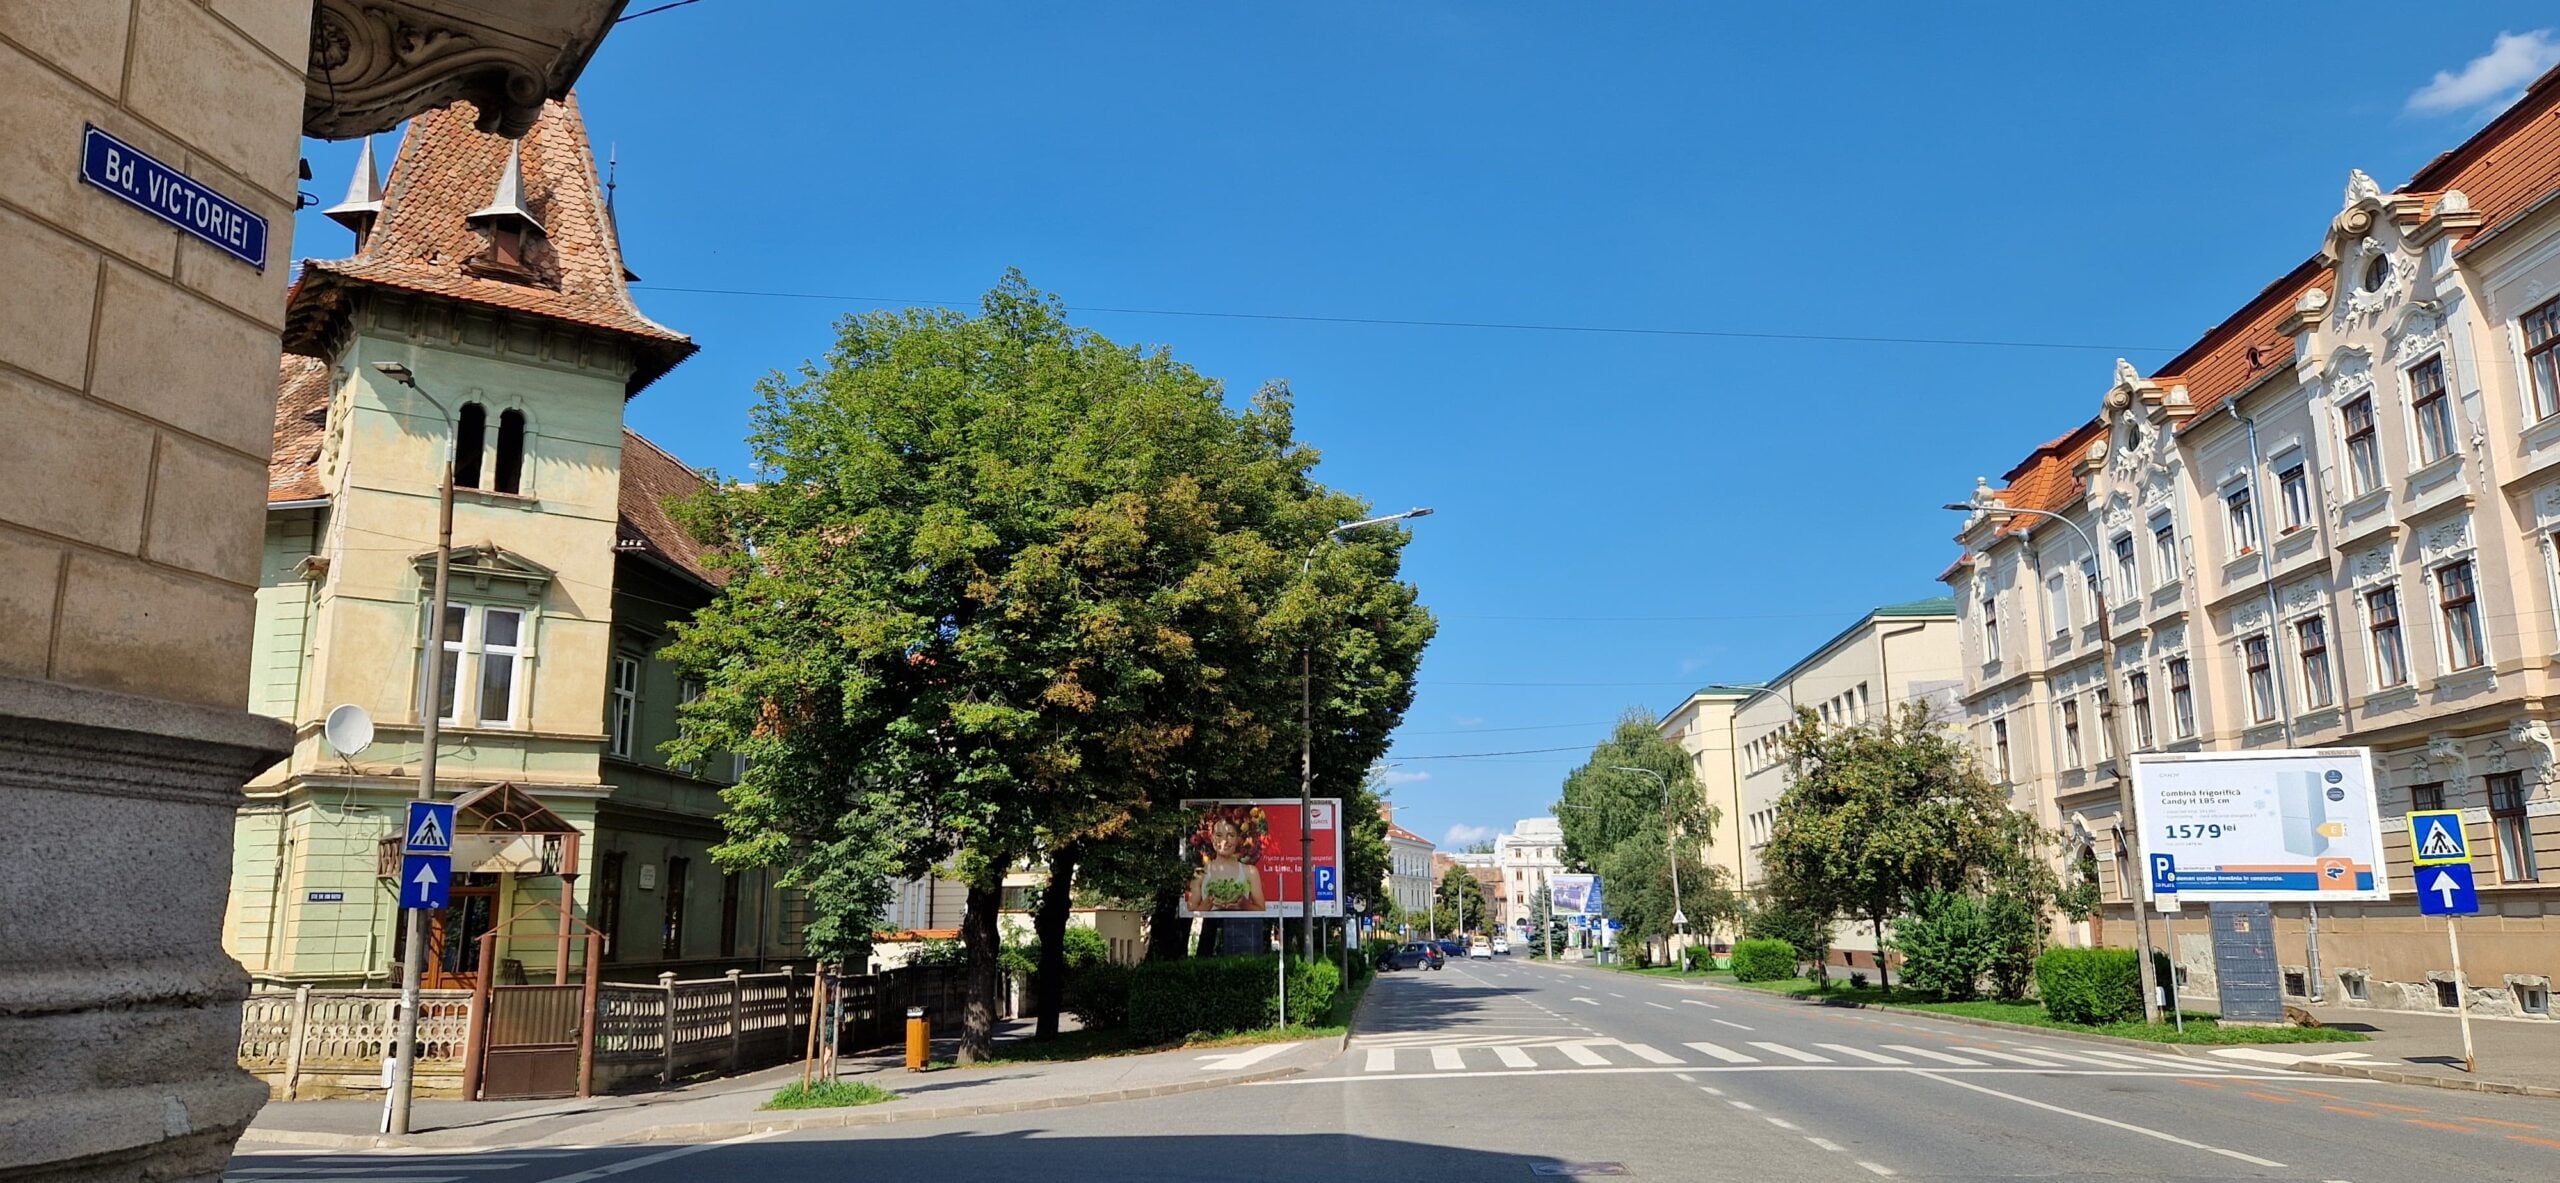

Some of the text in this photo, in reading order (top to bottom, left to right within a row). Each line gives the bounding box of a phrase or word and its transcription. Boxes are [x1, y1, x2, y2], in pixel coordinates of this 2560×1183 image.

[106, 148, 248, 249] Bd. VICTORIEI
[2161, 788, 2241, 797] Combină frigorifică
[2165, 824, 2222, 839] 1579
[2156, 857, 2169, 879] P
[1320, 870, 1330, 889] P
